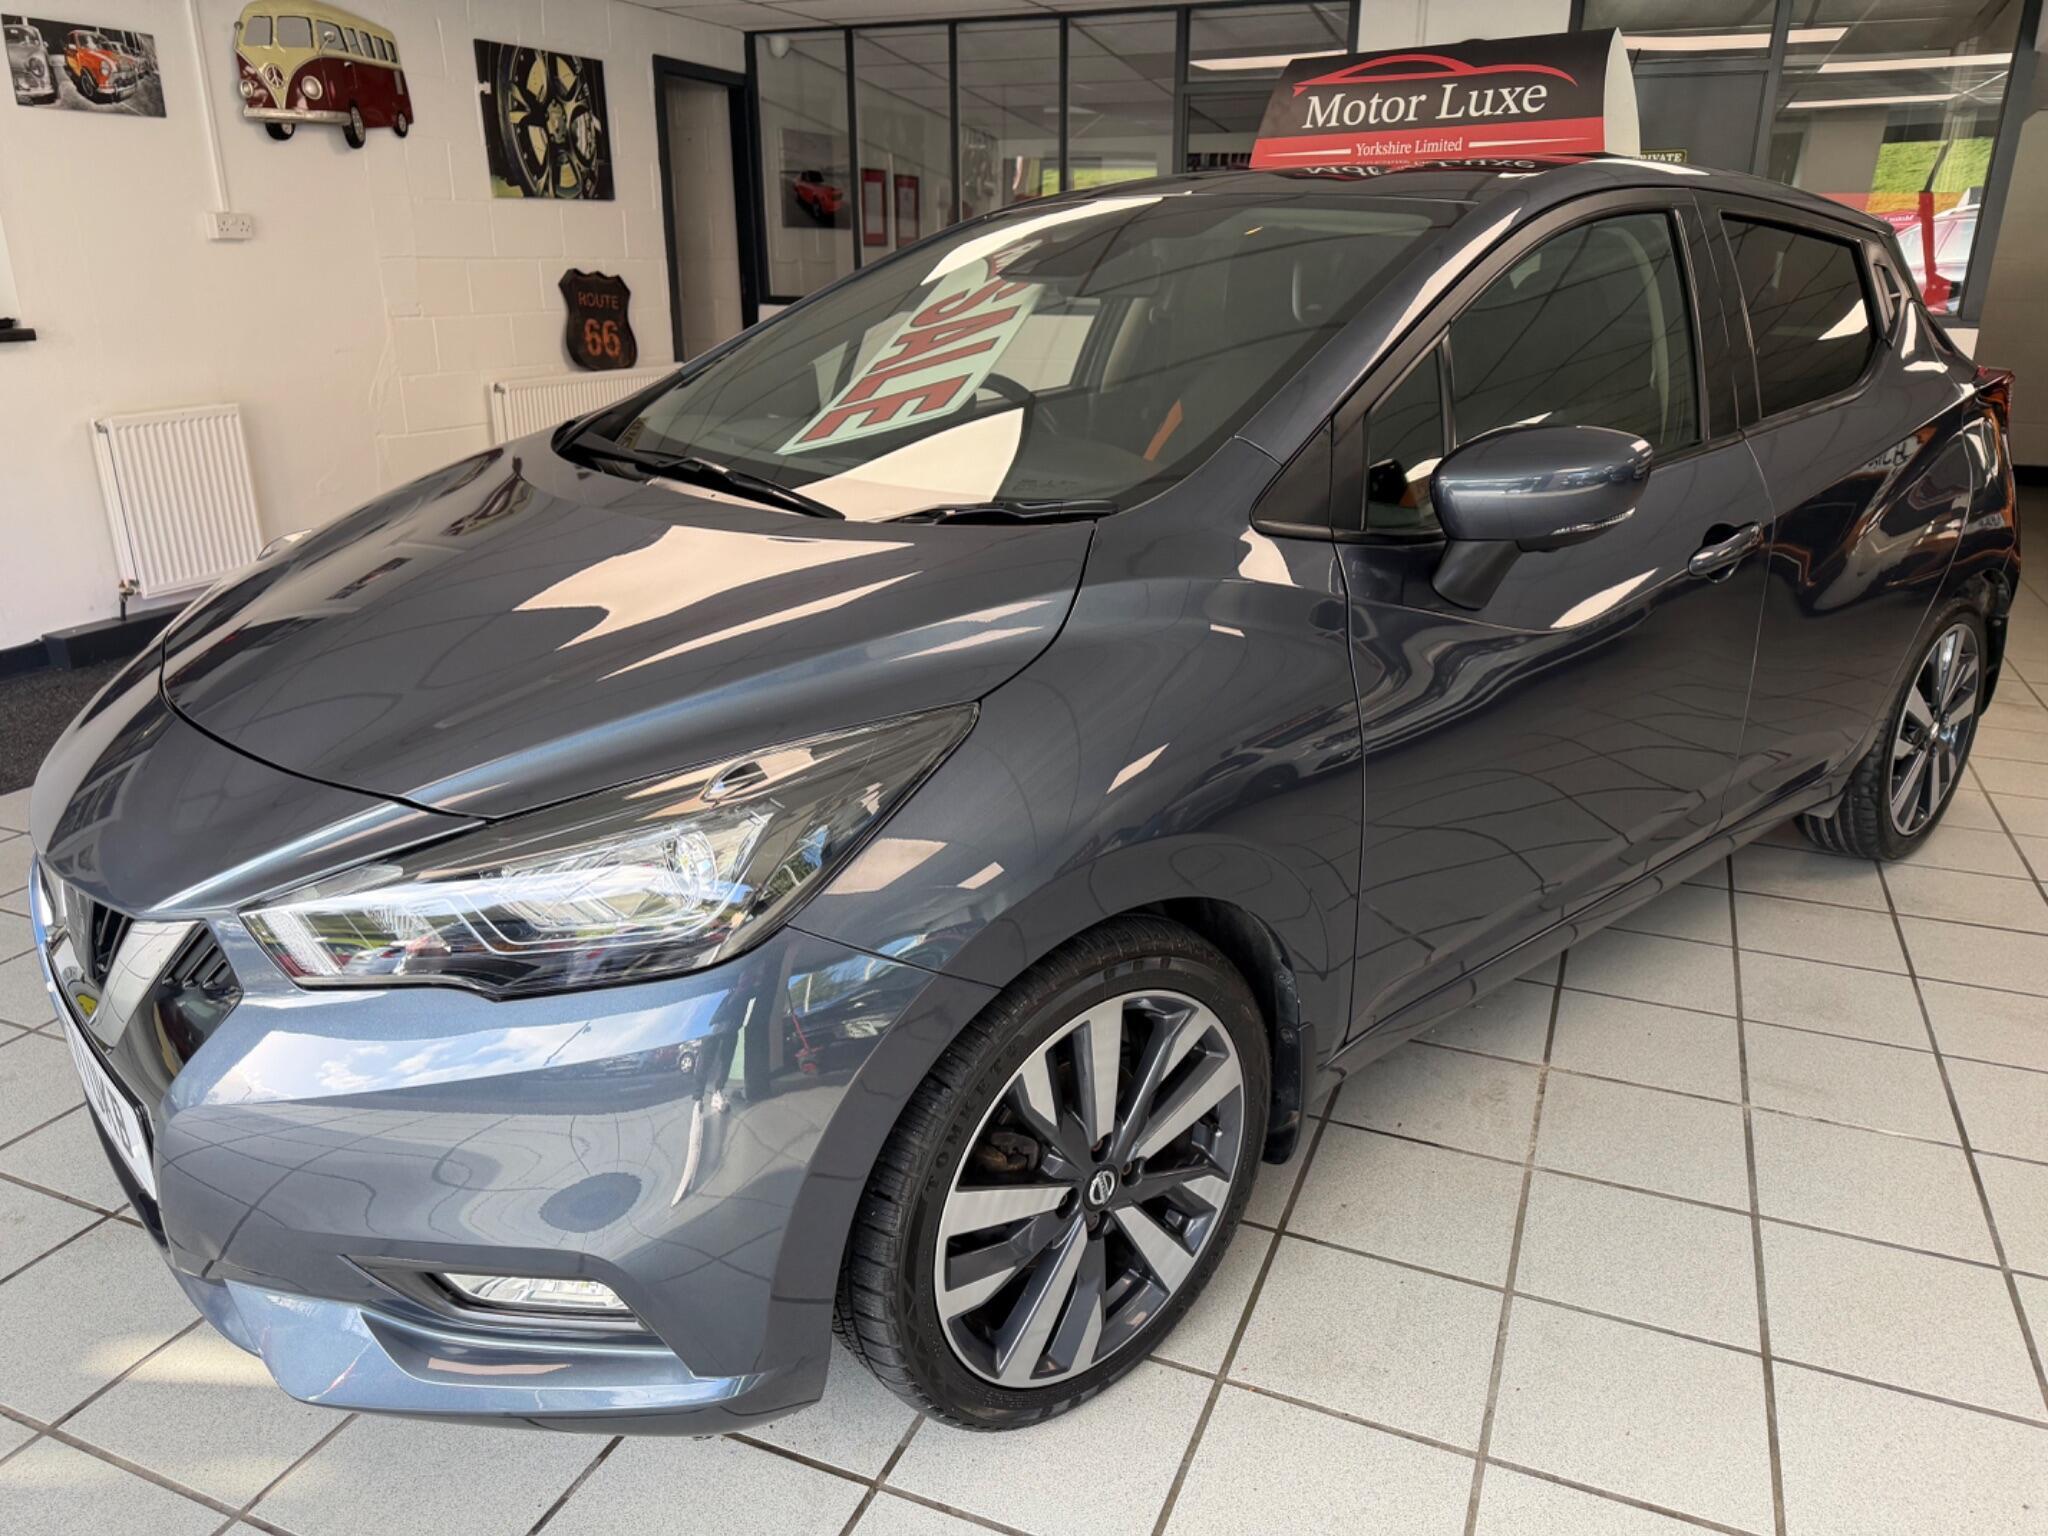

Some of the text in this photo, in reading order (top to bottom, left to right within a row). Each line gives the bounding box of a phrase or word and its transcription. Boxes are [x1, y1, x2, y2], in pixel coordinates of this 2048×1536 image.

[1301, 82, 1548, 129] Motor Luxe
[1355, 137, 1464, 157] Yorkshire Limited
[1639, 153, 1682, 162] RIVATE
[577, 290, 620, 310] ROUTE
[584, 318, 622, 358] 66
